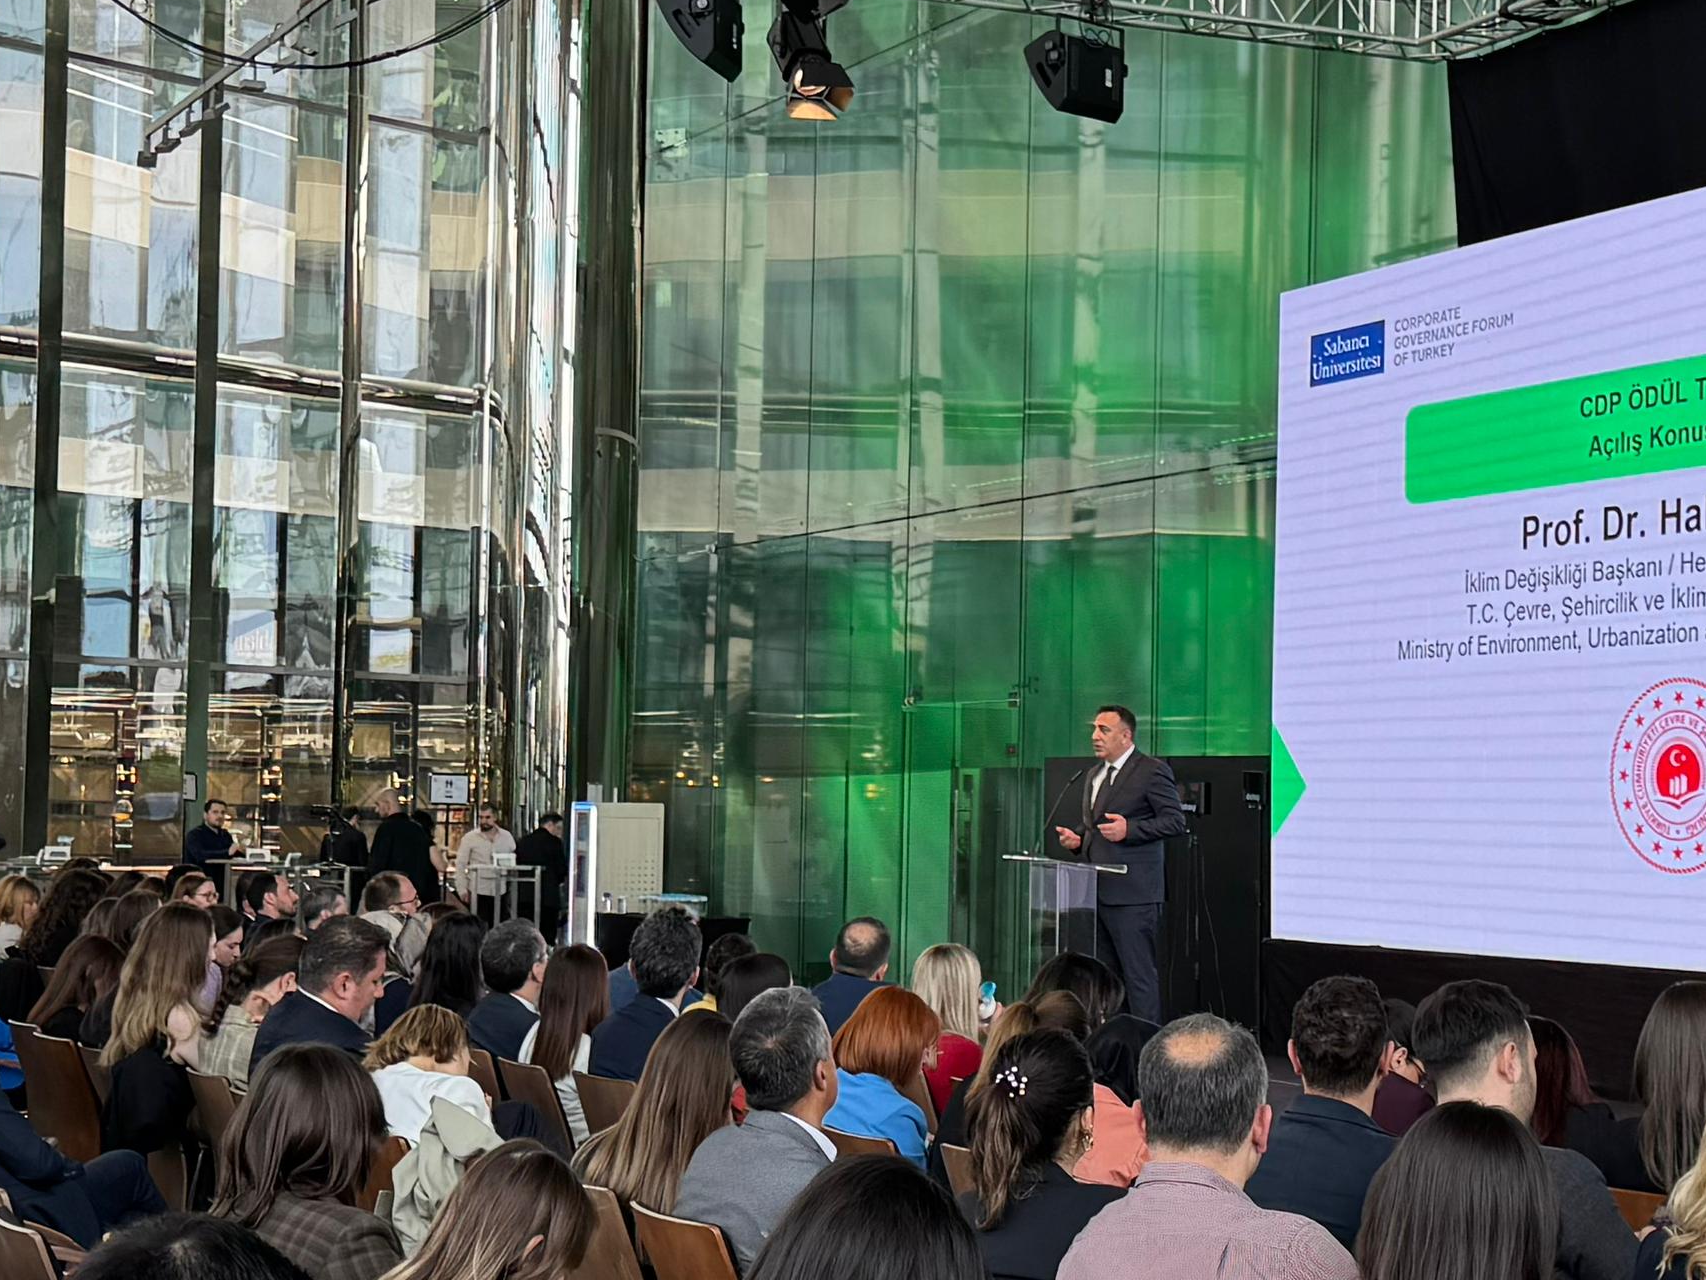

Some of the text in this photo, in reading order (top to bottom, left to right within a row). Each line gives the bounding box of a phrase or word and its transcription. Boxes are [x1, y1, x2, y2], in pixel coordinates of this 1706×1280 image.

[1394, 306, 1461, 333] CORPORATE
[1394, 313, 1514, 350] GOVERNANCE FORUM
[1393, 343, 1455, 367] OF TURKEY
[1580, 392, 1621, 418] CDP
[1629, 378, 1688, 410] ÖDÜL
[1588, 431, 1642, 461] Açılış
[1522, 509, 1590, 550] Prof.
[1603, 506, 1645, 541] Dr.
[1464, 569, 1500, 594] İklim
[1505, 562, 1587, 593] Değişikliği
[1593, 557, 1663, 586] Başkanı
[1667, 553, 1675, 576] /
[1467, 603, 1498, 625] T.C.
[1503, 600, 1556, 627] Çevre,
[1561, 591, 1638, 624] Şehircilik
[1644, 594, 1665, 611] ve
[1398, 638, 1454, 663] Ministry
[1458, 636, 1474, 657] of
[1477, 629, 1582, 655] Environment,
[1588, 623, 1699, 649] Urbanization
